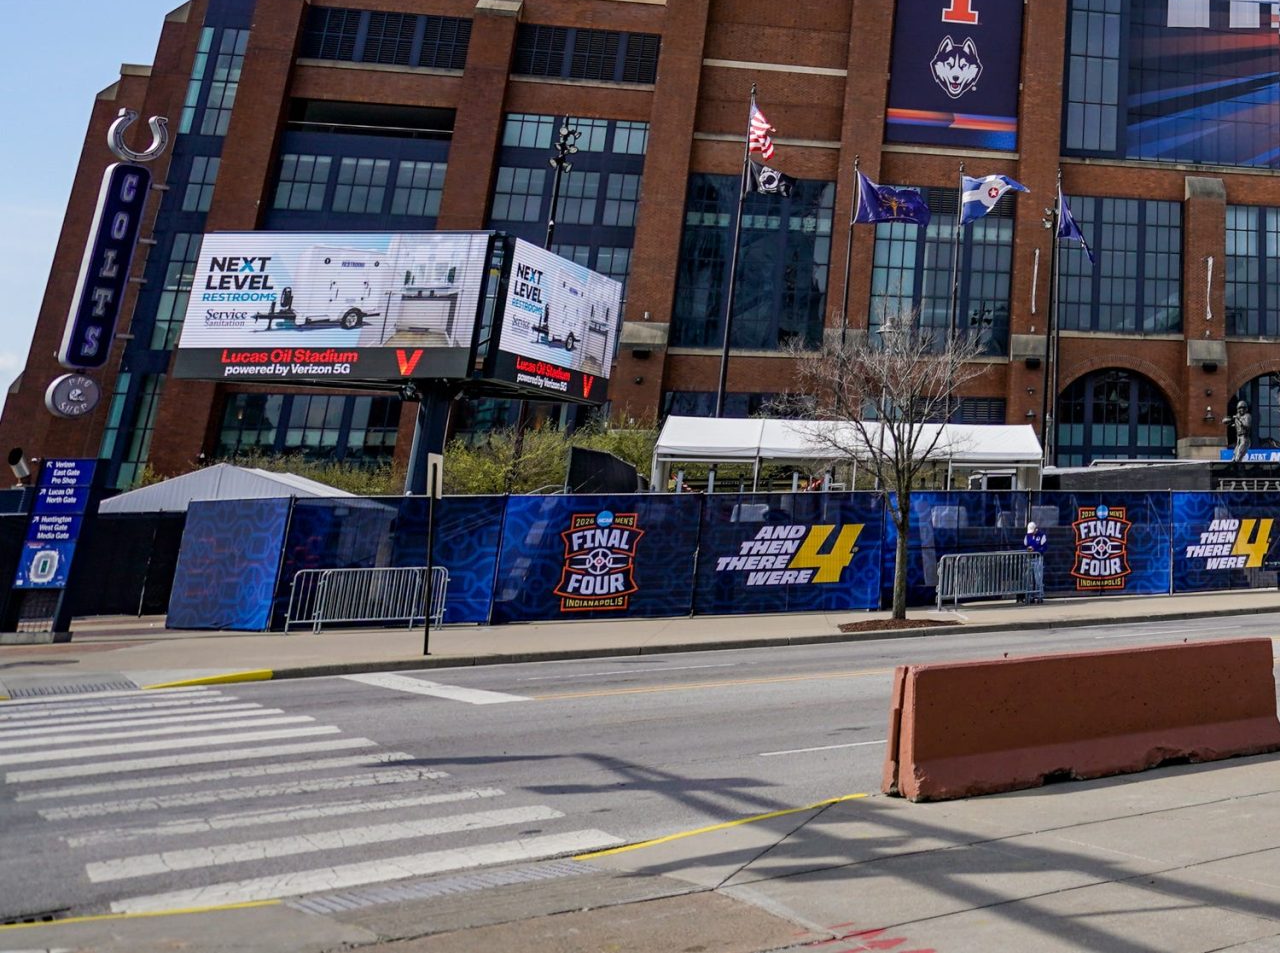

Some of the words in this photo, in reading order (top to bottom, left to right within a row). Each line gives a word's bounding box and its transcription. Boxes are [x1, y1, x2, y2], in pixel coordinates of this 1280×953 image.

[80, 174, 140, 357] COLTS
[209, 257, 271, 272] NEXT
[516, 263, 543, 285] NEXT
[205, 275, 274, 290] LEVEL
[202, 293, 277, 301] RESTROOMS
[514, 280, 542, 304] LEVEL
[205, 308, 248, 320] Service
[221, 349, 269, 363] Lucas
[271, 349, 292, 363] Oil
[294, 349, 358, 362] Stadium
[224, 364, 274, 376] powered
[275, 364, 289, 376] by
[291, 364, 332, 374] Verizon
[333, 364, 350, 374] 5G
[516, 355, 536, 373] Lucas
[546, 365, 570, 381] Stadium
[69, 377, 93, 388] PRO
[59, 402, 88, 415] SHOP
[41, 516, 72, 524] Huntington
[575, 518, 594, 527] 2026
[615, 517, 634, 526] MEN'S
[1208, 519, 1239, 531] AND
[754, 525, 807, 540] AND
[1080, 520, 1122, 539] FINAL
[572, 529, 629, 551] FINAL
[1200, 531, 1236, 544] THEN
[1230, 518, 1274, 568] 4
[739, 540, 800, 555] THEN
[788, 523, 865, 584] 4
[1186, 544, 1232, 558] THERE
[716, 555, 790, 571] THERE
[1080, 558, 1122, 576] FOUR
[1206, 556, 1246, 570] WERE
[566, 573, 624, 595] FOUR
[746, 569, 813, 586] WERE
[1080, 578, 1121, 586] INDIANAPOLIS
[566, 597, 623, 607] INDIANAPOLIS
